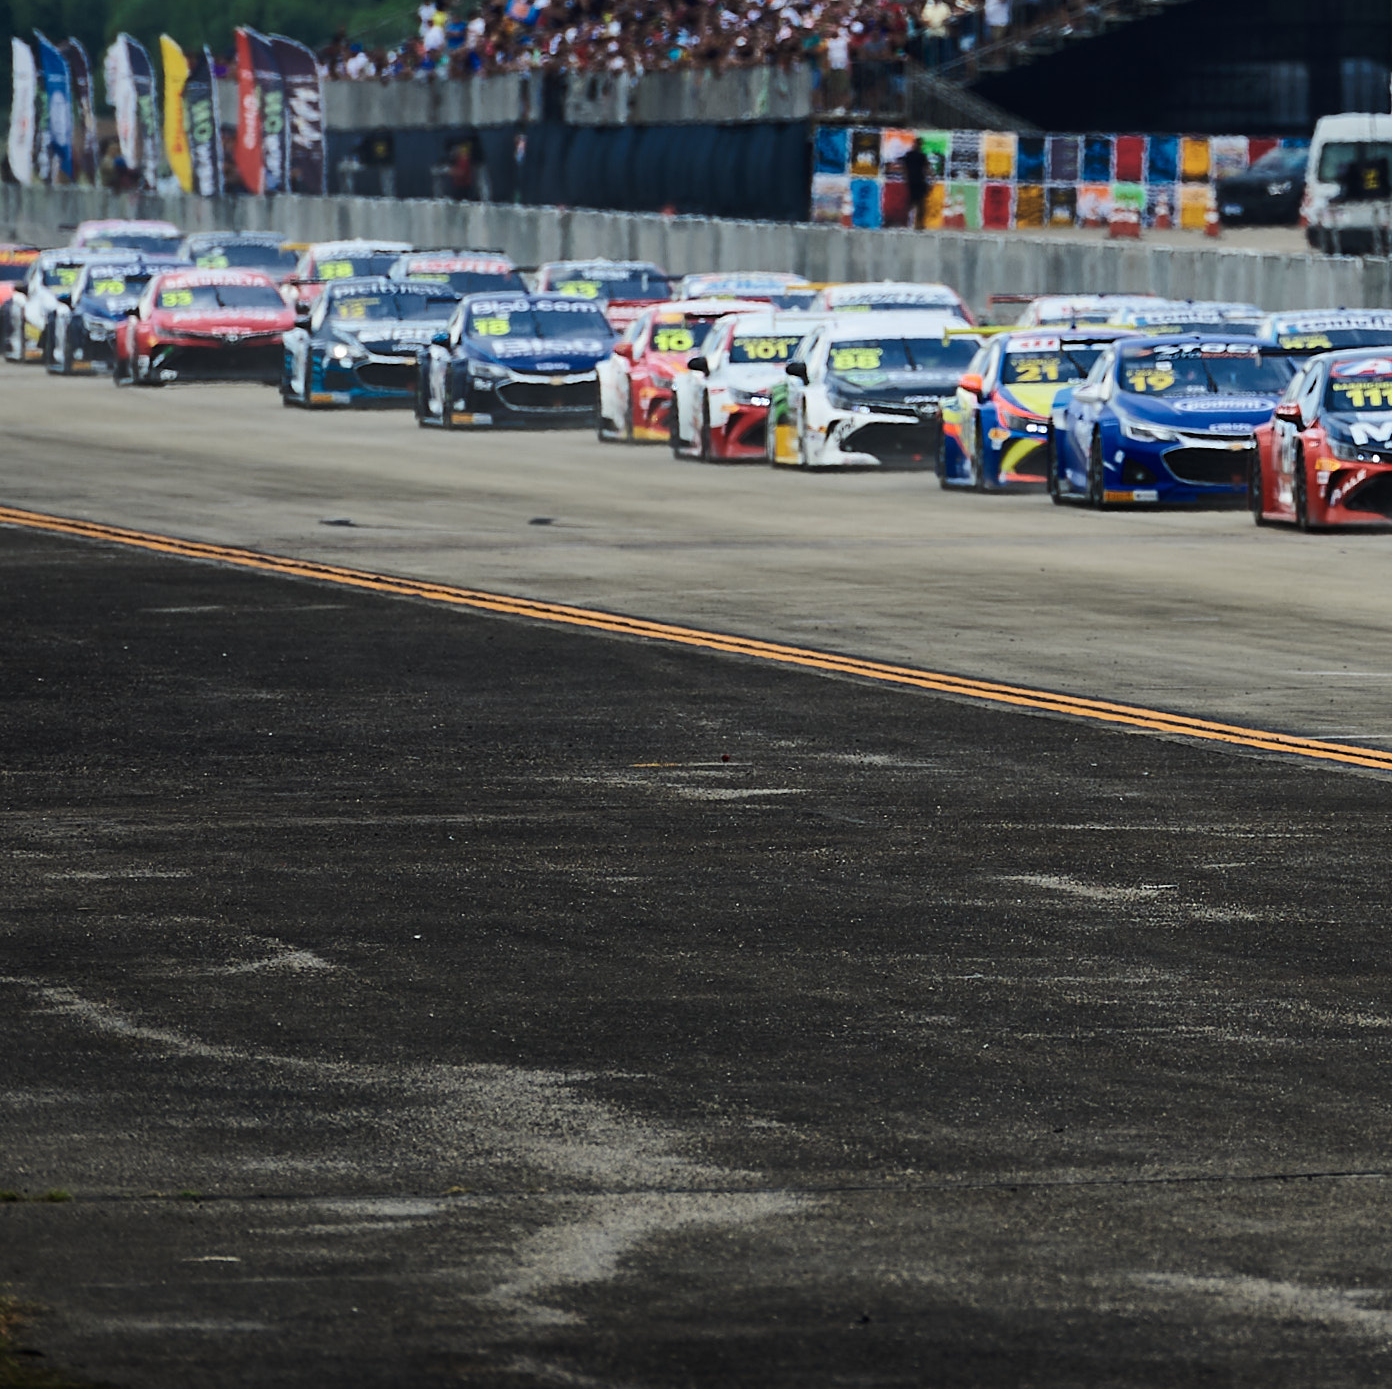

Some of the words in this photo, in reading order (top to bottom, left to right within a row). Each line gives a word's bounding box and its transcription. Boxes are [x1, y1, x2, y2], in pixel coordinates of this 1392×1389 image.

[161, 290, 193, 307] 33
[654, 332, 694, 352] 10
[743, 342, 789, 359] 101
[833, 352, 881, 370] 88
[1015, 362, 1059, 382] 21
[1129, 373, 1175, 391] 19
